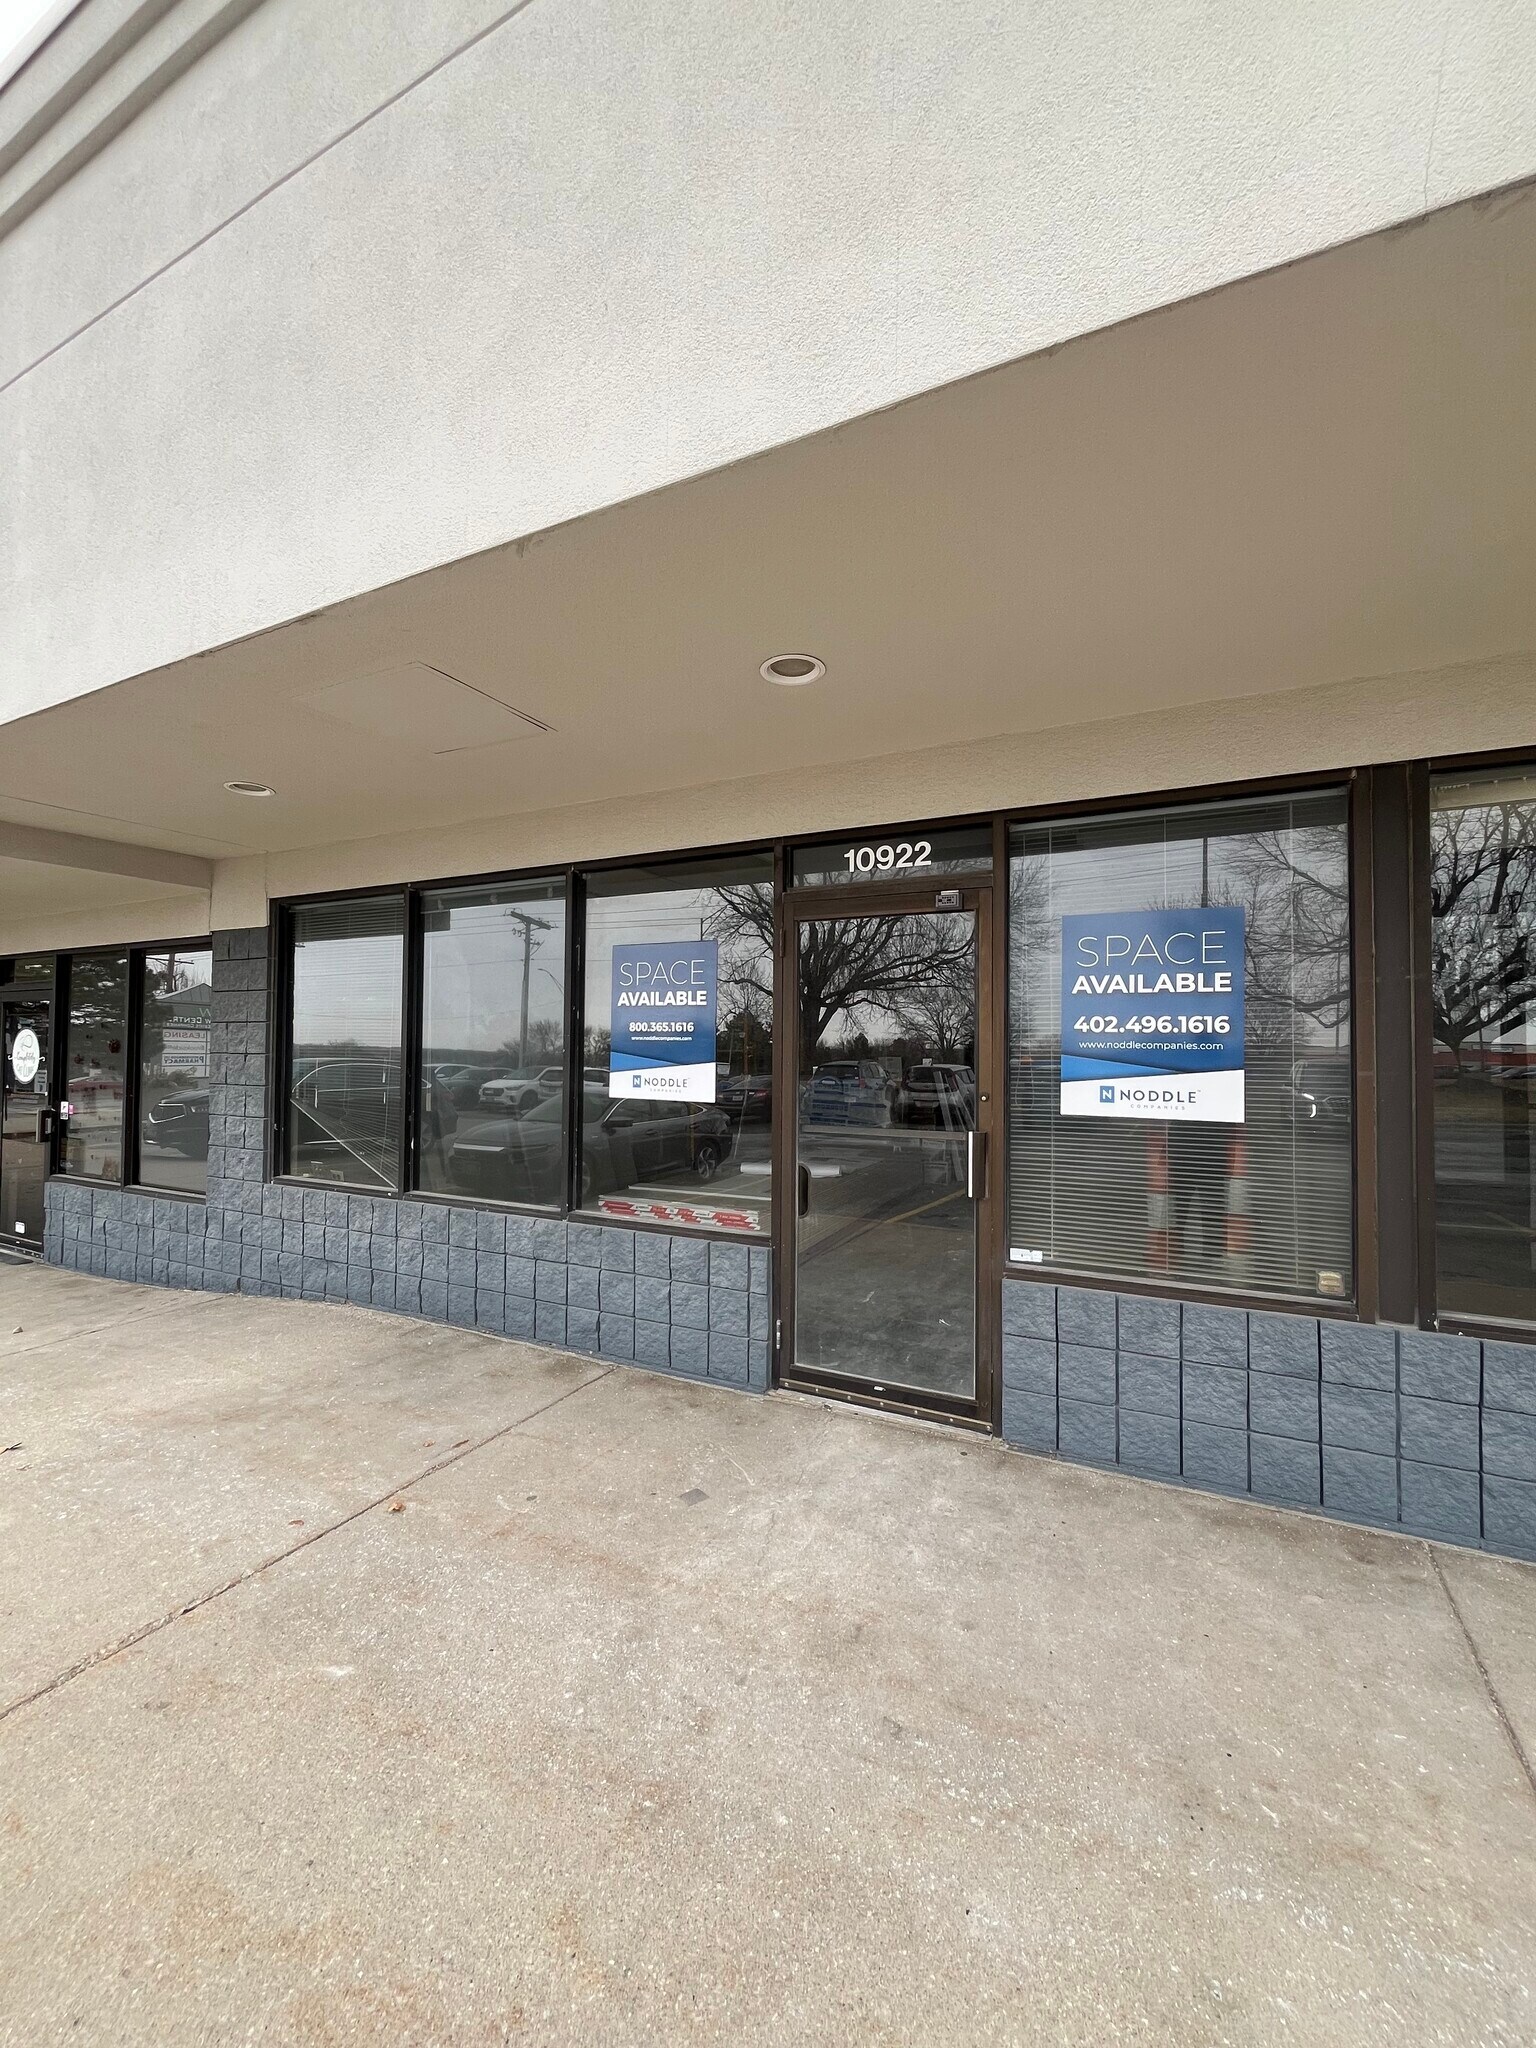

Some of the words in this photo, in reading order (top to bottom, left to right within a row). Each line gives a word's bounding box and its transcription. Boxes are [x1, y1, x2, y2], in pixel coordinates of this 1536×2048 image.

[843, 841, 932, 873] 10922
[1076, 930, 1227, 967] SPACE
[619, 959, 706, 986] SPACE
[1071, 972, 1232, 995] AVAILABLE
[617, 990, 707, 1007] AVAILABLE
[628, 1021, 695, 1033] 800.365.1616
[1073, 1015, 1231, 1034] 402.496.1616
[1078, 1040, 1224, 1051] www.noddlecompanies.com
[644, 1077, 688, 1087] NODDLE
[1120, 1089, 1197, 1104] NODDLE
